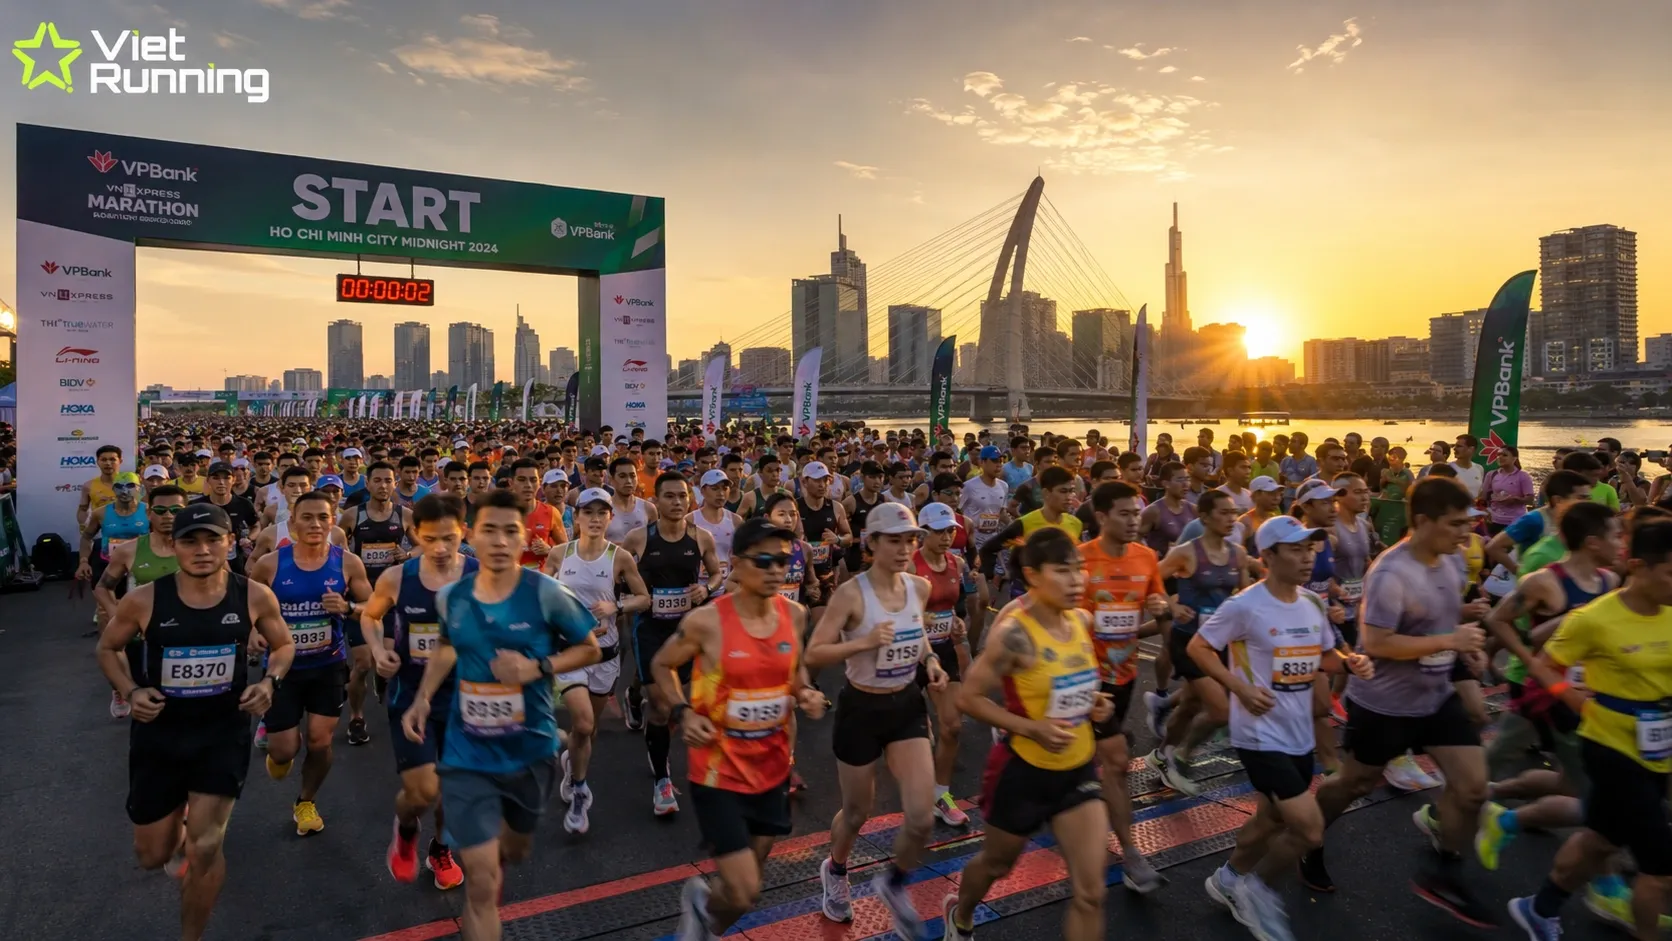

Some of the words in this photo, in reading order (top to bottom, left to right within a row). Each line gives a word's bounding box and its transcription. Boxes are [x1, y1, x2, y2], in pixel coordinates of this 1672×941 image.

[121, 160, 197, 182] VPBank
[88, 194, 199, 217] MARATHON
[292, 173, 481, 233] START
[270, 226, 292, 238] HO
[297, 228, 322, 240] CHI
[327, 230, 363, 244] MINH
[367, 234, 397, 246] CITY
[402, 236, 465, 251] MIDNIGHT
[468, 242, 499, 254] 2024
[570, 226, 614, 240] VPBank
[61, 265, 112, 278] VPBank
[341, 278, 430, 302] 00:00:02
[626, 298, 654, 307] VPBank
[60, 379, 84, 387] BIDV
[1490, 341, 1515, 427] VPBank
[802, 382, 812, 421] VPBank
[937, 376, 948, 421] VPBank
[60, 404, 95, 413] HOKA
[60, 456, 96, 466] HOKA
[171, 662, 227, 679] E8370
[1282, 662, 1314, 676] 8381
